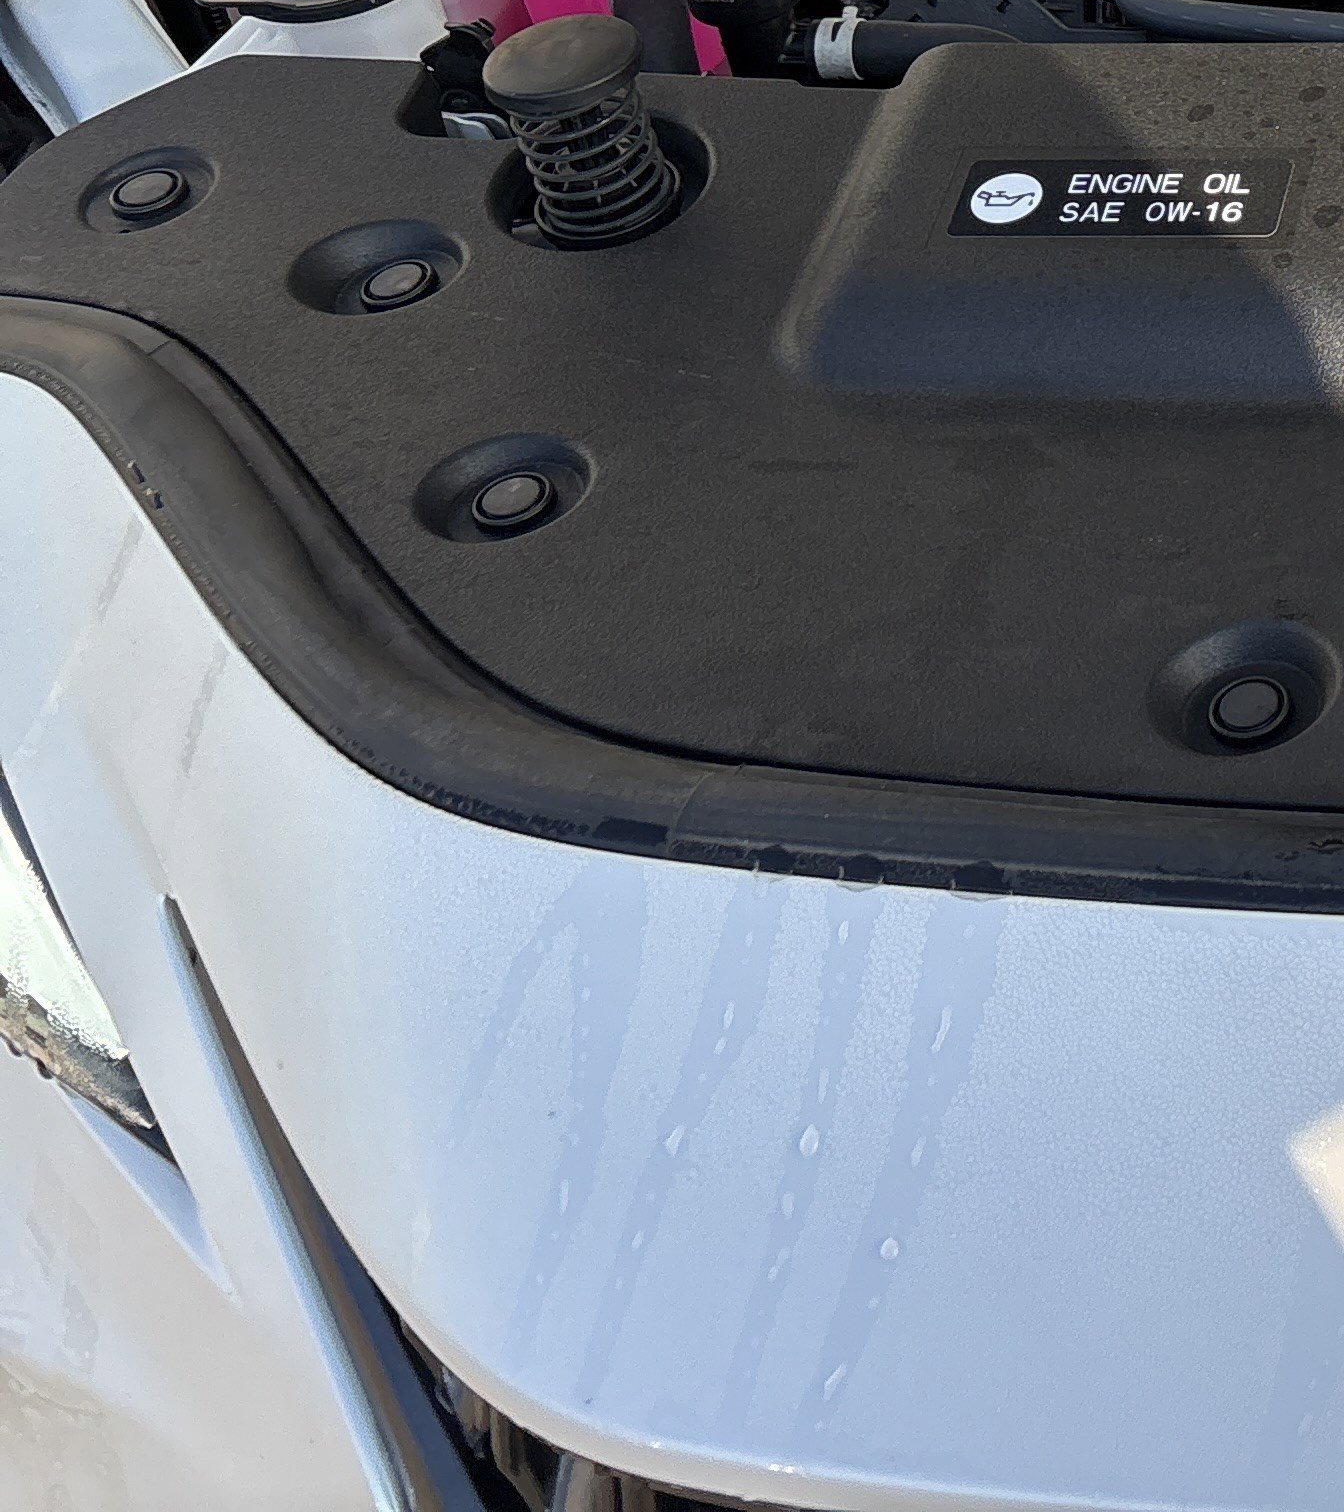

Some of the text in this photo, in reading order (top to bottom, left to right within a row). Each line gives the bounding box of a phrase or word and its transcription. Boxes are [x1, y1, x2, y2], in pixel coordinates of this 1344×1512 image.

[1066, 173, 1251, 195] ENGINE OIL
[1058, 201, 1244, 223] SAE 0W-16
